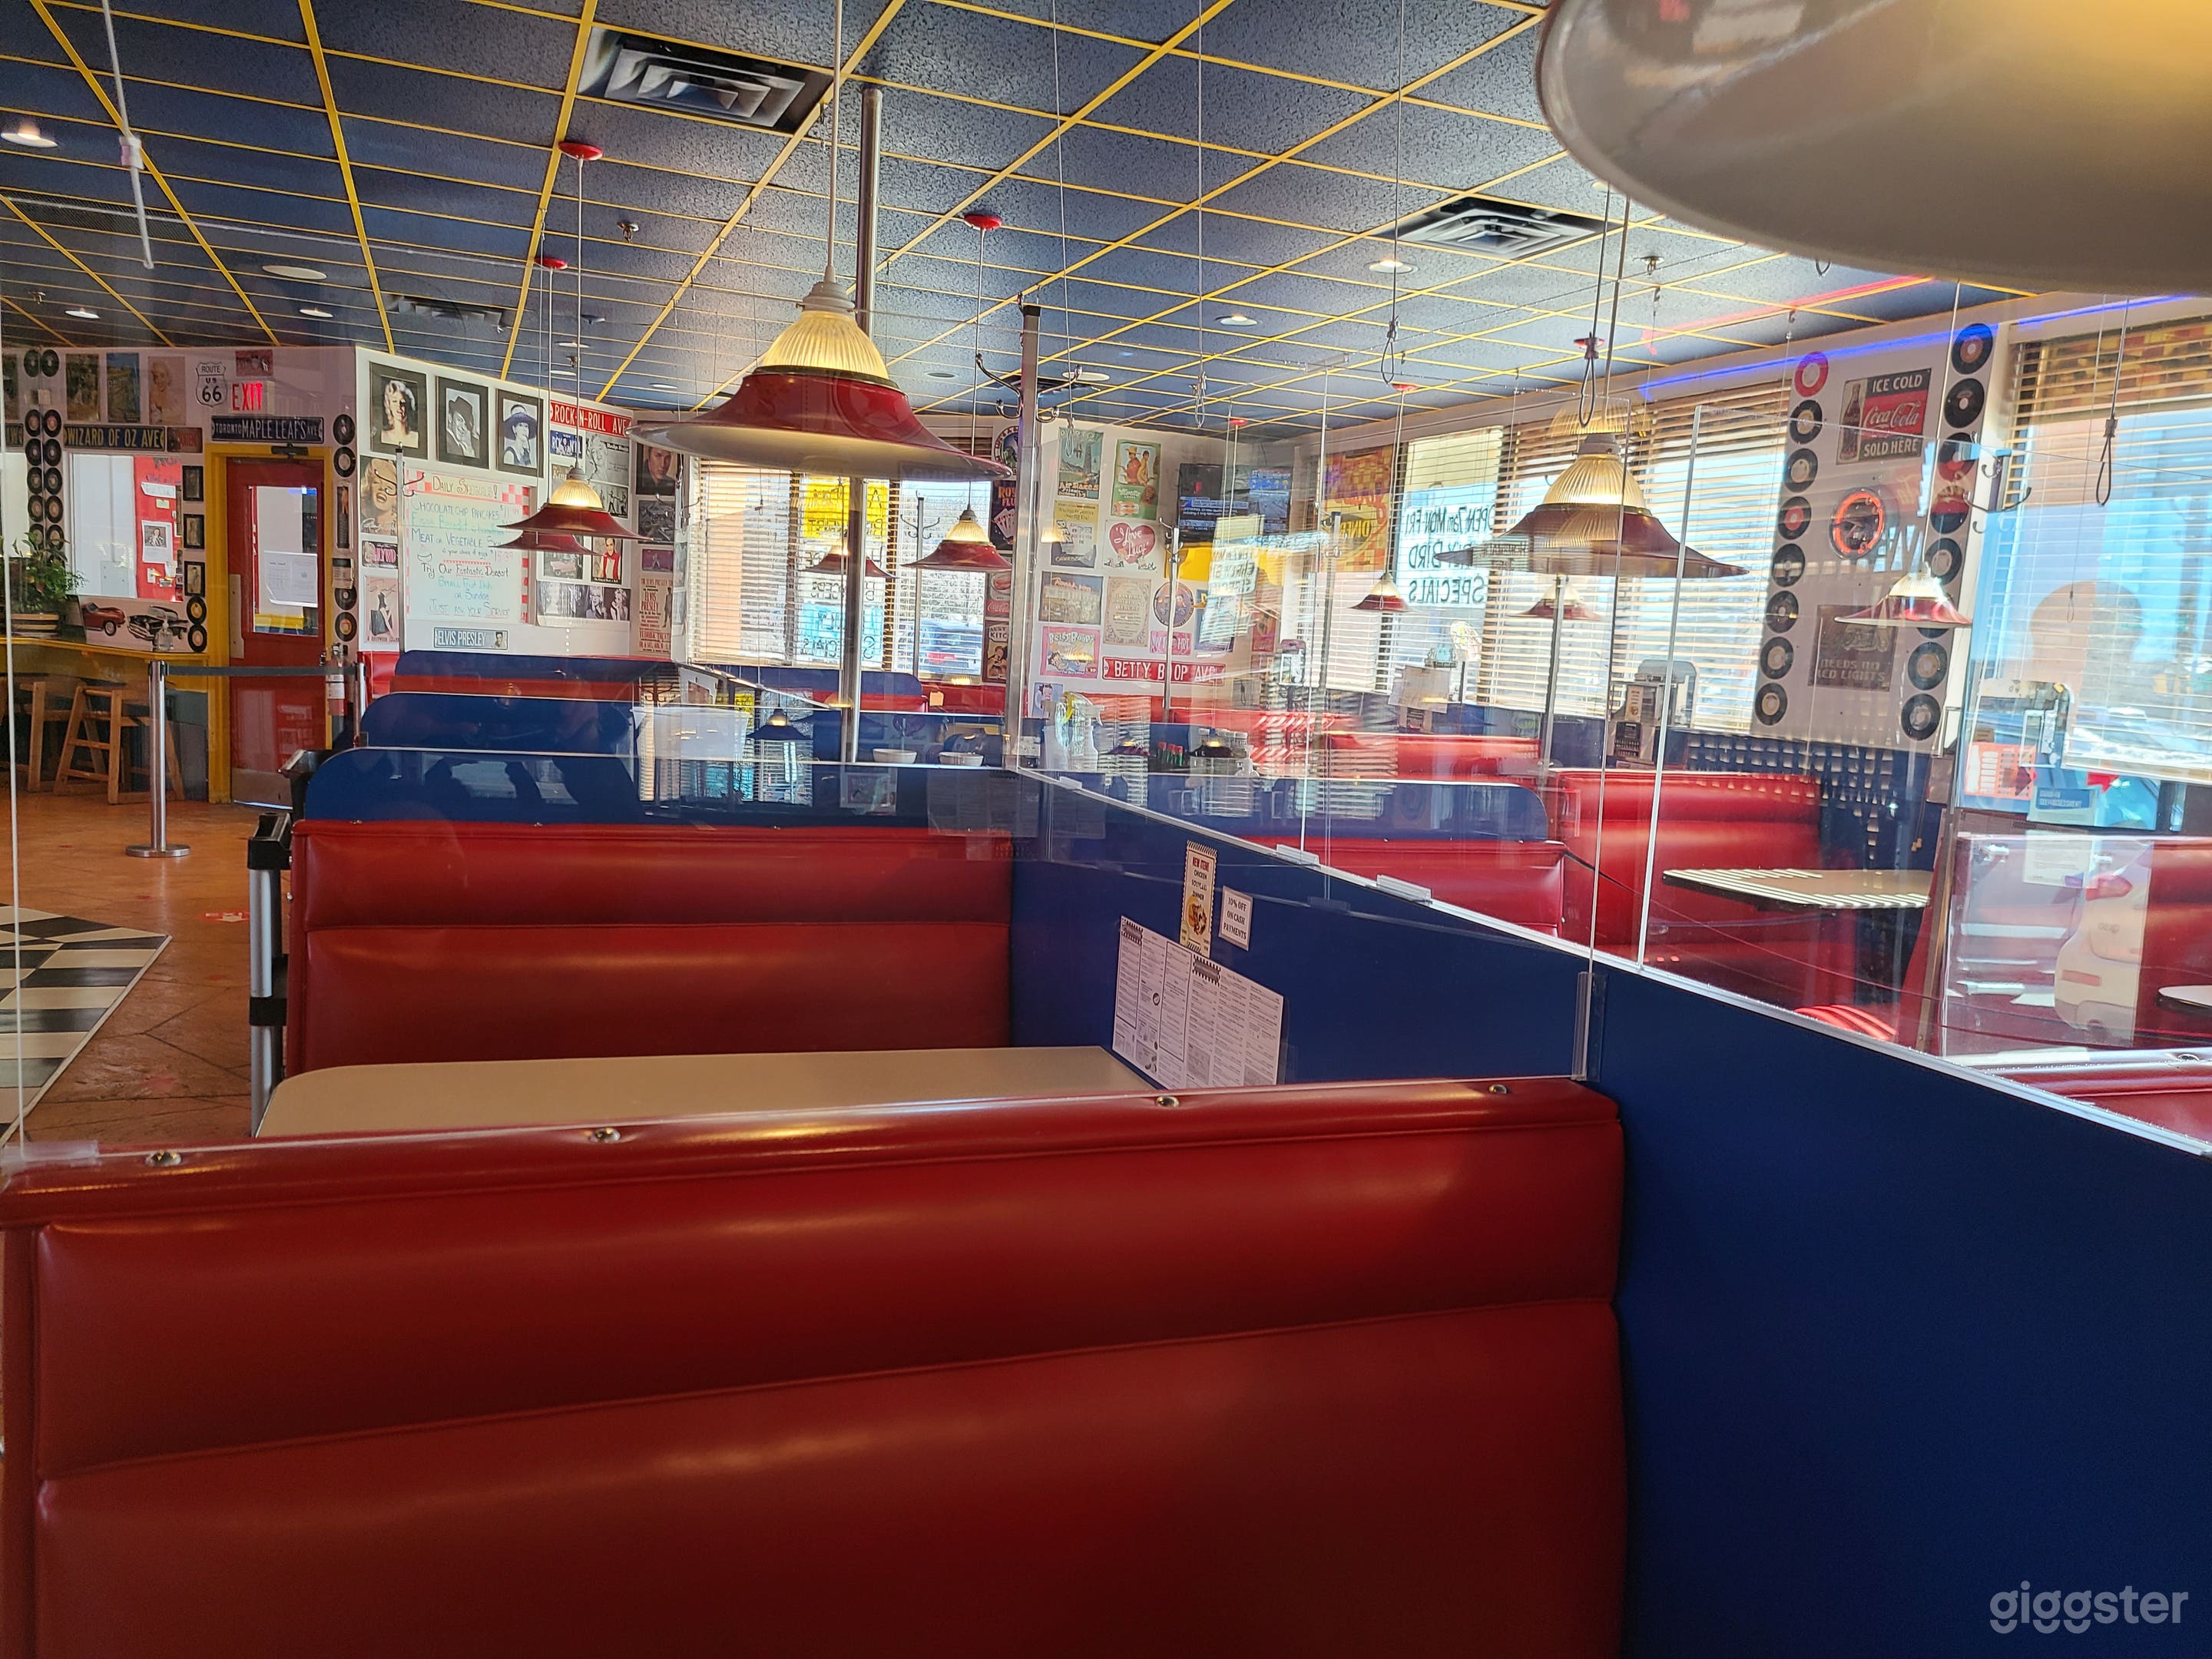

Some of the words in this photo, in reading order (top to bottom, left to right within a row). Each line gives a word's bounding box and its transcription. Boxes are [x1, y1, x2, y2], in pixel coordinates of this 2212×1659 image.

[201, 365, 220, 373] ROUTE
[1873, 379, 1890, 393] ICE
[1892, 374, 1922, 390] COLD
[202, 386, 222, 402] 66
[232, 382, 263, 411] EXIT
[216, 425, 242, 435] TORONTO
[242, 420, 273, 440] MAPLE
[276, 419, 306, 440] LEAFS
[307, 427, 317, 435] AVE
[612, 419, 627, 435] AVE
[68, 429, 104, 448] WIZARD
[108, 429, 120, 447] OF
[124, 429, 137, 447] OZ
[141, 429, 159, 448] AVE
[1863, 442, 1888, 457] SOLD
[1890, 439, 1919, 453] HERE
[412, 528, 434, 544] MEAT
[437, 629, 456, 646] ELVIS
[458, 631, 487, 647] PRESLEY
[1114, 660, 1151, 680] BETTY
[1157, 664, 1188, 681] BOP
[1194, 869, 1207, 880] CHICKEN
[1228, 897, 1238, 908] 10%
[1238, 901, 1247, 912] OFF
[1227, 911, 1234, 920] ON
[1233, 914, 1246, 926] CASH
[1223, 922, 1247, 940] PAYMENTS
